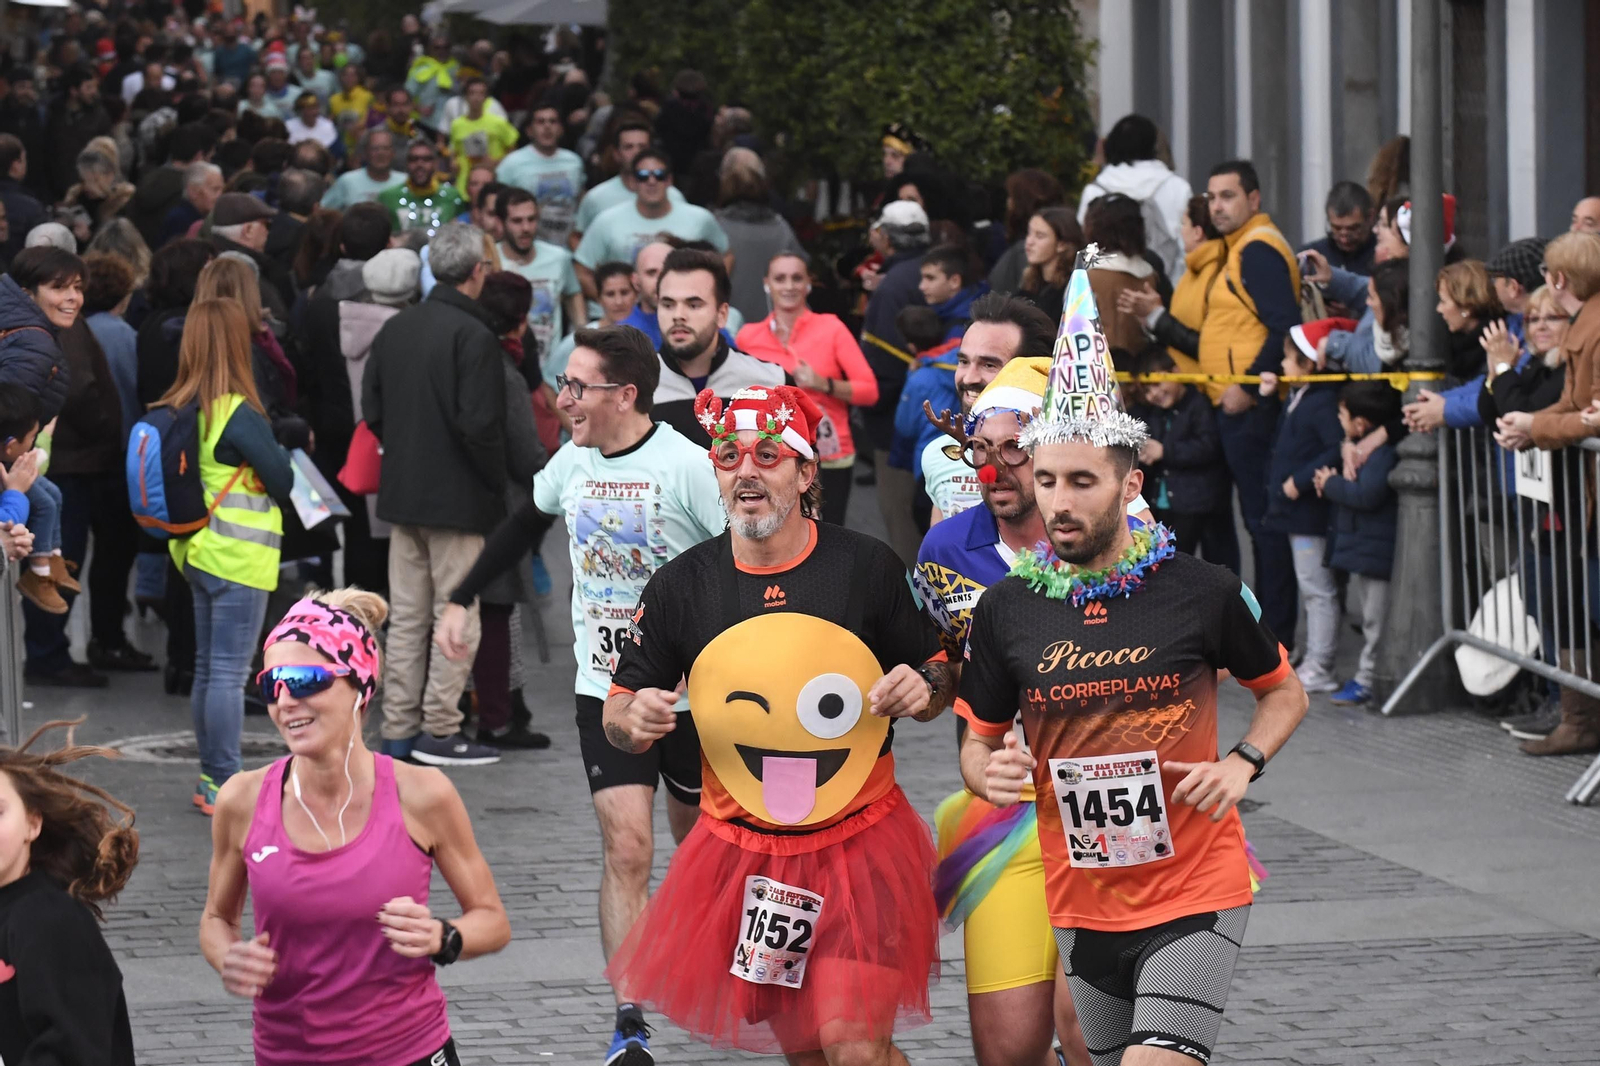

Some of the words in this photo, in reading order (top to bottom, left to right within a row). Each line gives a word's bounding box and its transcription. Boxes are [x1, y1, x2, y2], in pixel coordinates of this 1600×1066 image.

[1058, 364, 1106, 393] NEW
[1055, 395, 1110, 422] YEAR
[1083, 617, 1108, 626] mobel
[1037, 640, 1157, 674] Picoco
[1050, 673, 1181, 701] CORREPLAYAS
[1061, 784, 1163, 829] 1454
[746, 906, 813, 954] 1652
